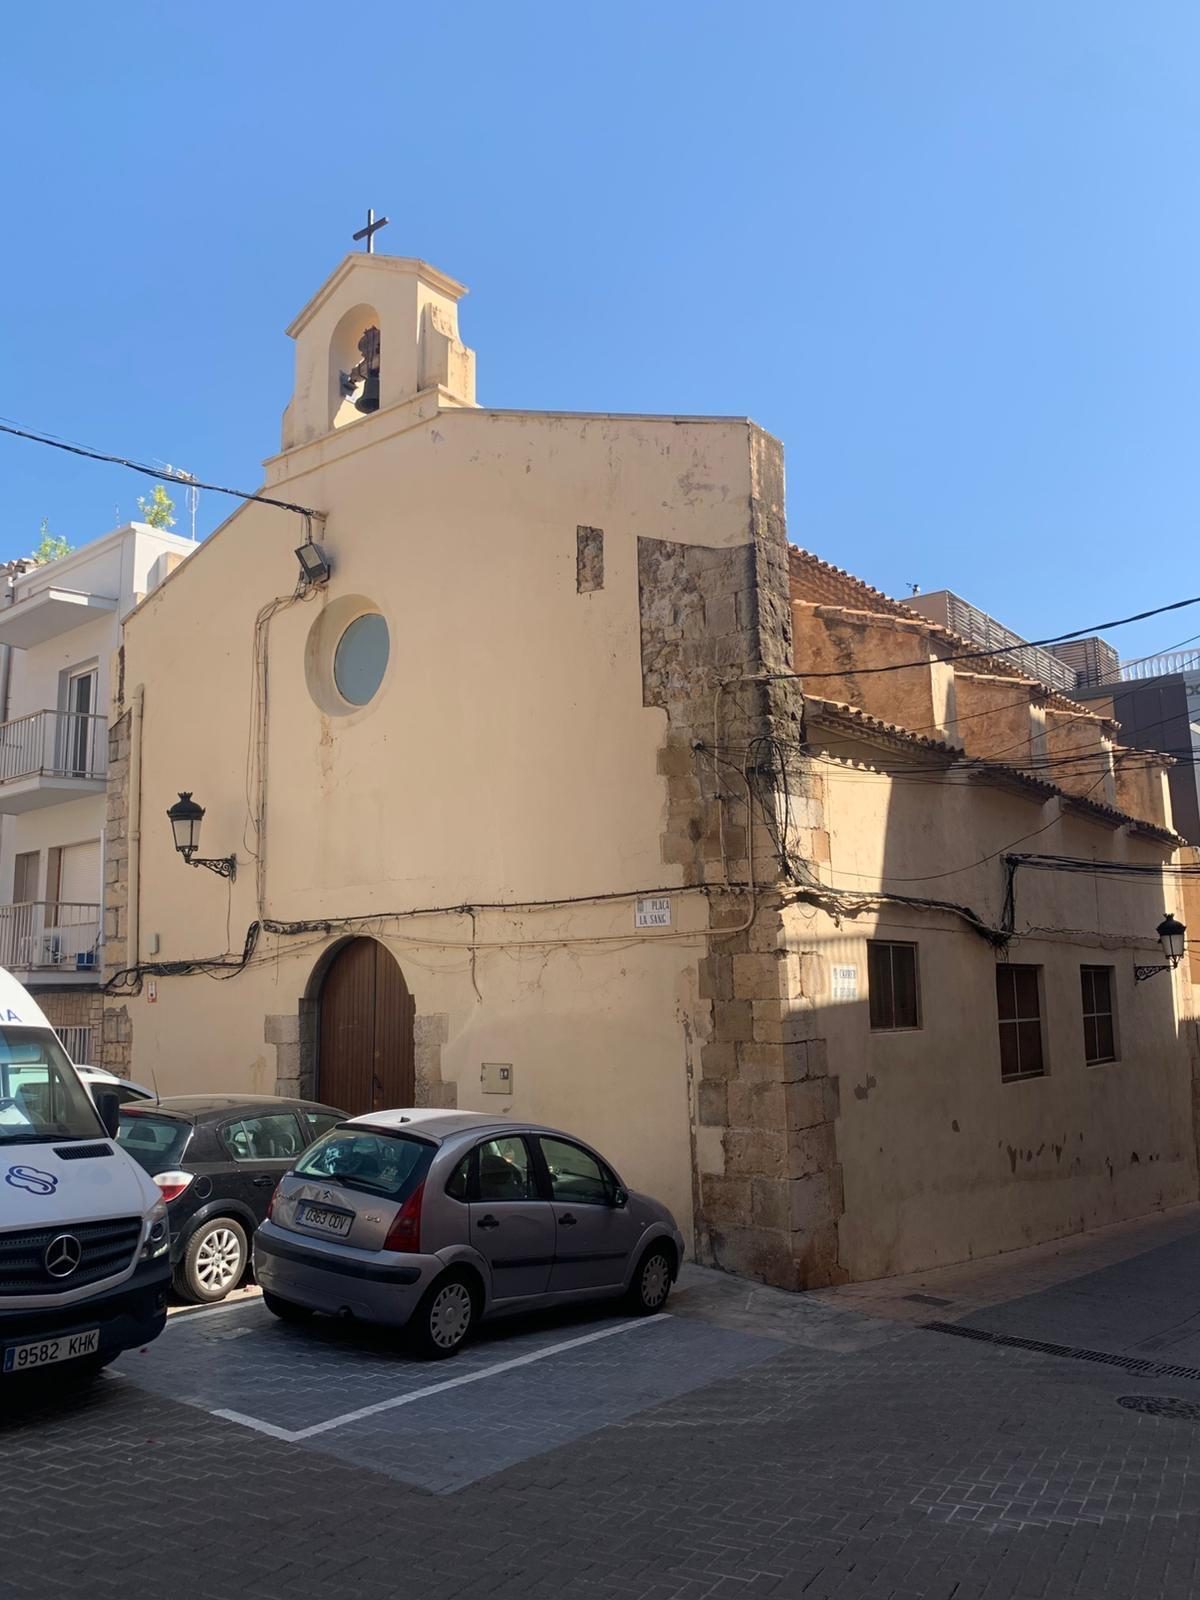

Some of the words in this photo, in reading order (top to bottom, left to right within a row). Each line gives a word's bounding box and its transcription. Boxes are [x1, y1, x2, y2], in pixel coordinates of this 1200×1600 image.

[305, 1208, 328, 1225] 0363
[328, 1213, 347, 1230] CDV
[18, 1342, 60, 1366] 9582
[68, 1333, 97, 1355] KHK
